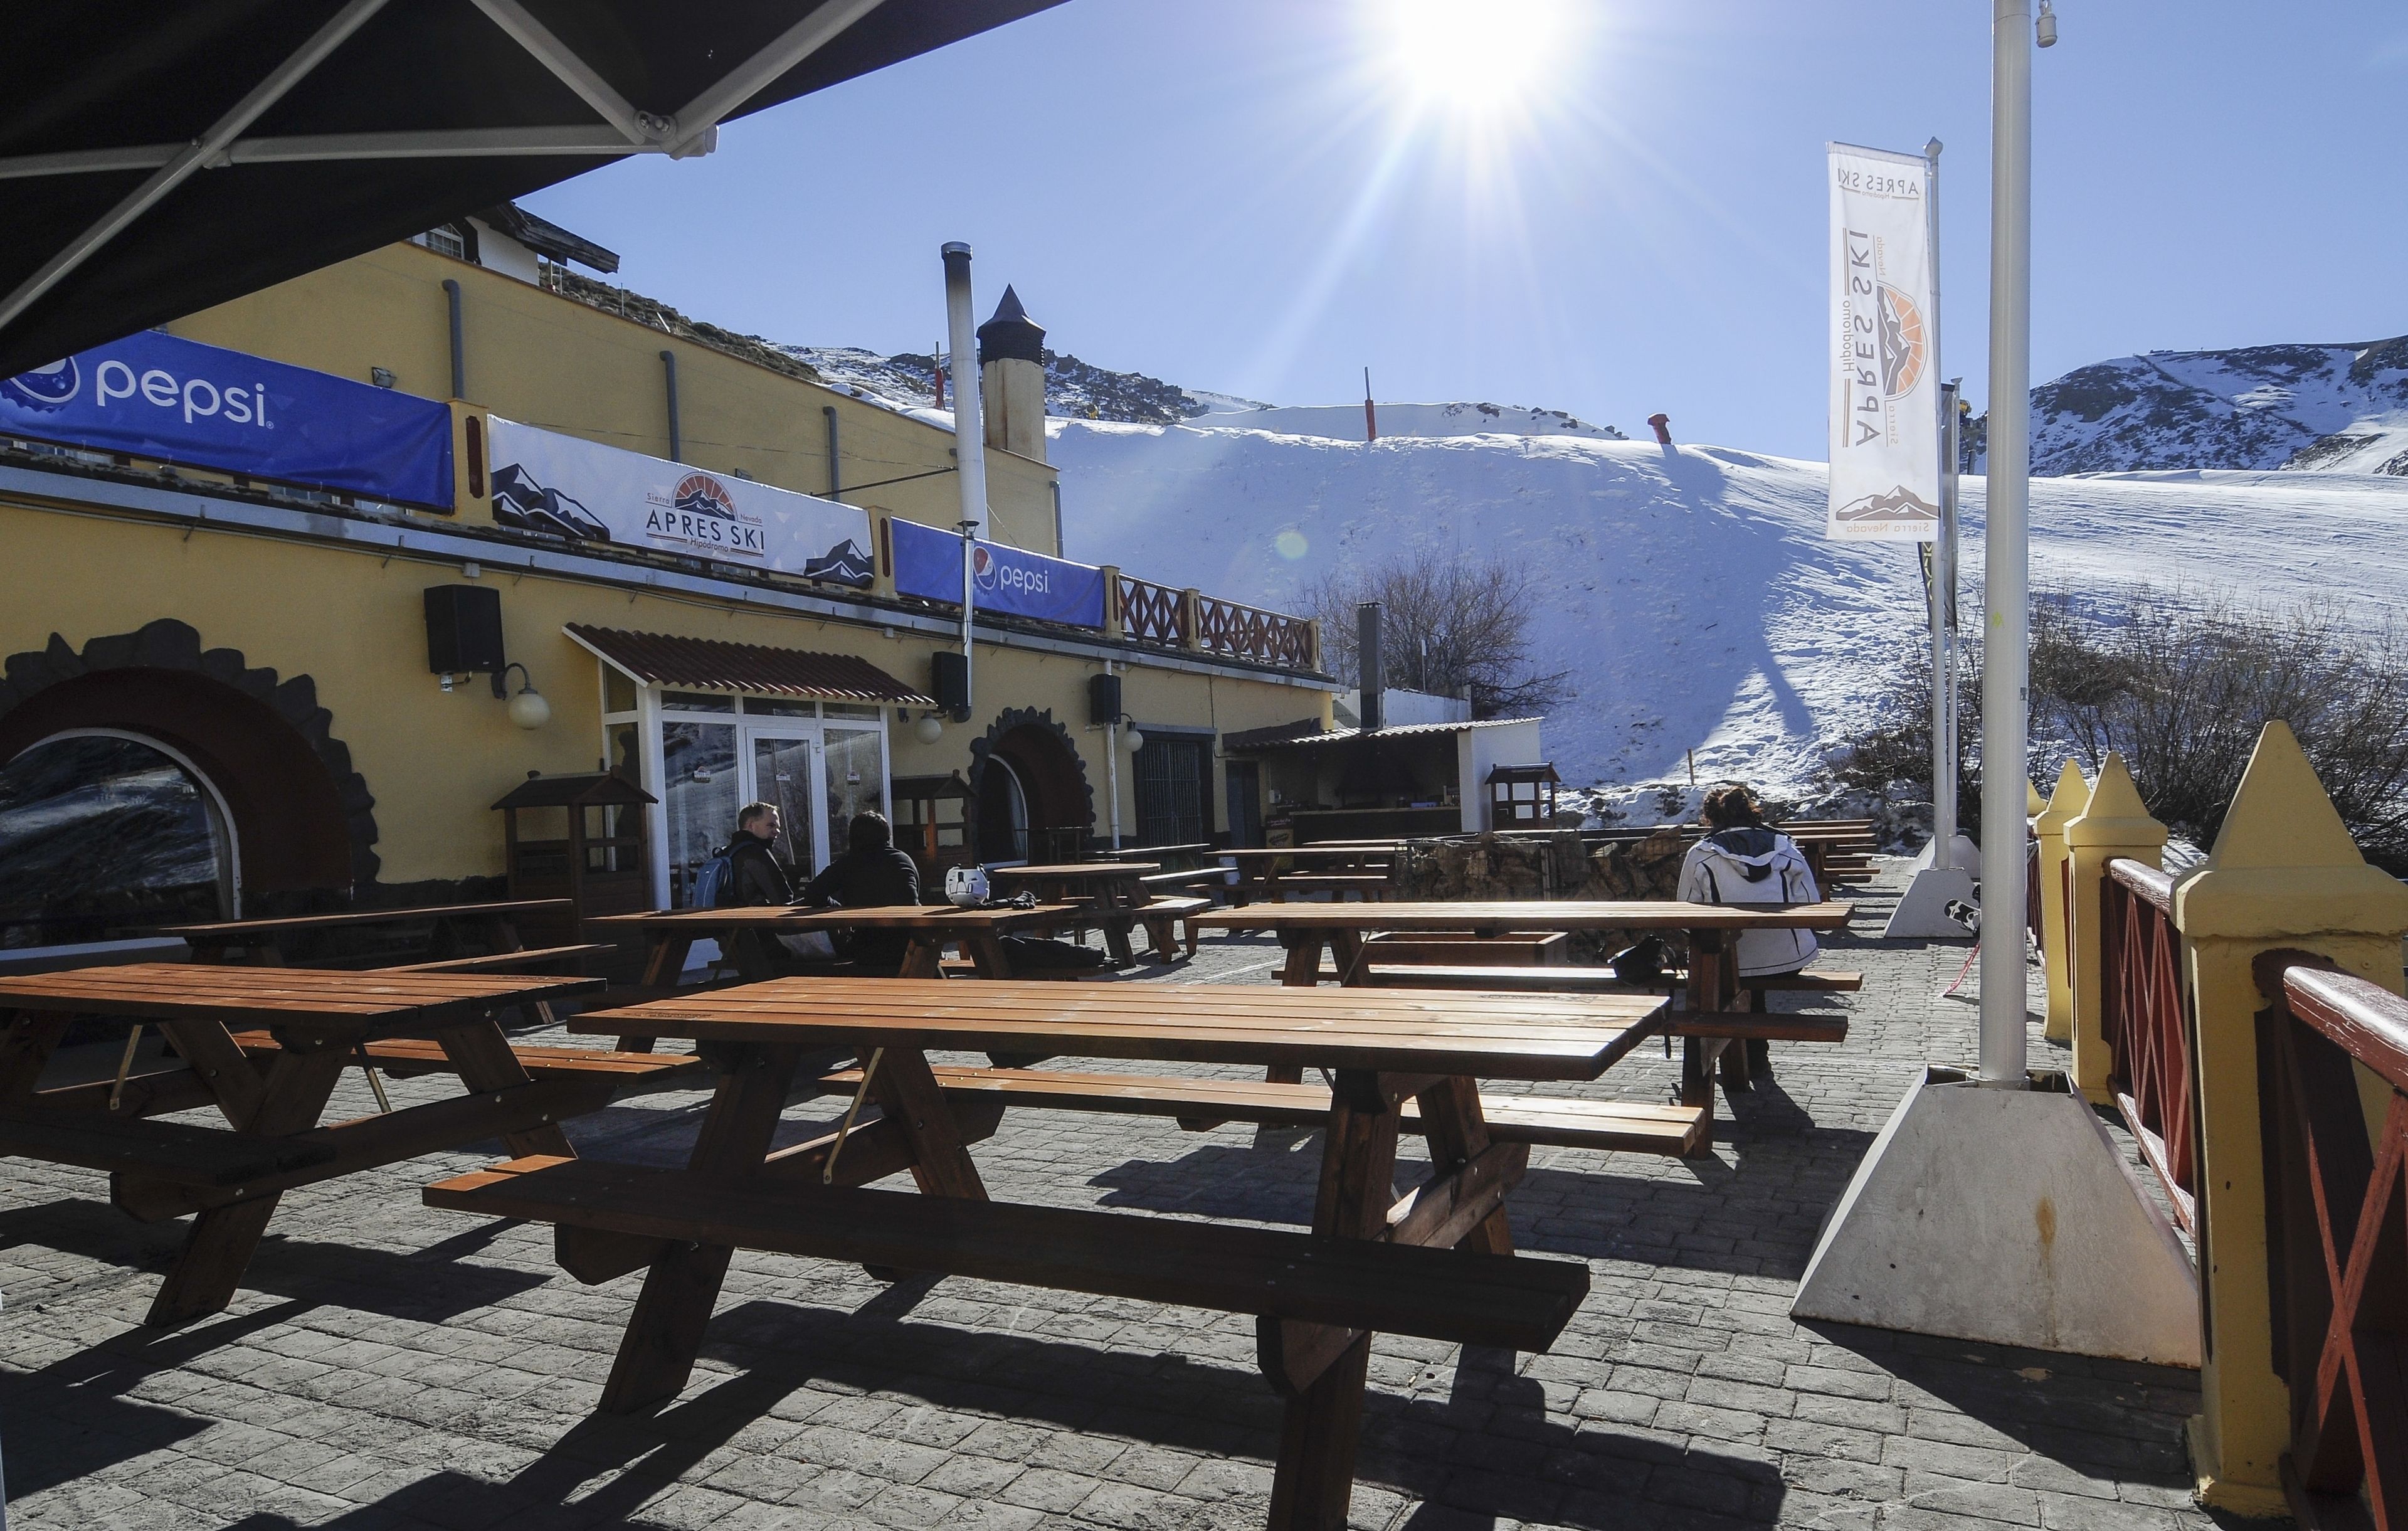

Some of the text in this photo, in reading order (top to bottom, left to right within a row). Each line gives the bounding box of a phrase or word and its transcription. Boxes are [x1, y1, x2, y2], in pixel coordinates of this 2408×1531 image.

[97, 360, 265, 427] pepsi
[647, 492, 670, 504] Sierra
[646, 509, 764, 550] APRES SKI
[740, 514, 763, 524] Nevada
[690, 538, 729, 552] Hipódromo
[1000, 565, 1048, 595] pepsi
